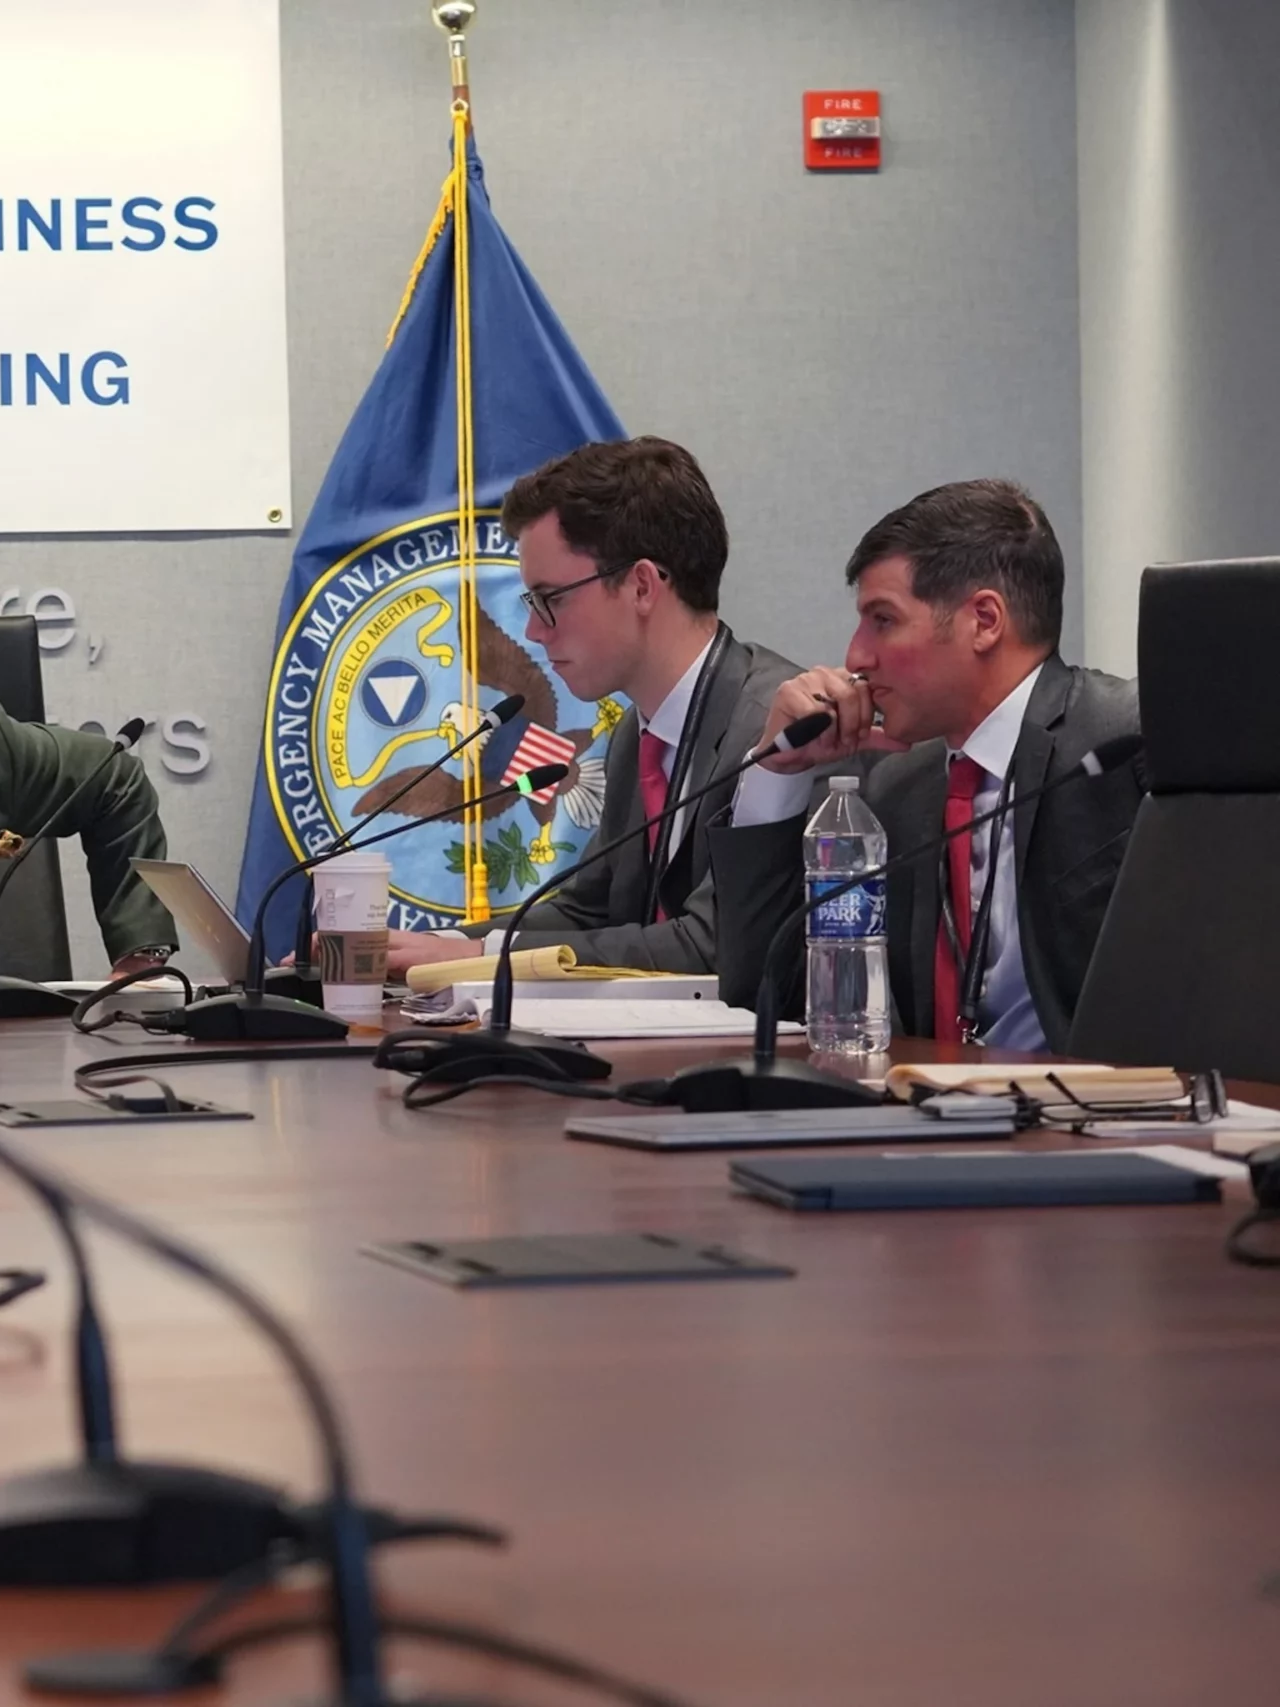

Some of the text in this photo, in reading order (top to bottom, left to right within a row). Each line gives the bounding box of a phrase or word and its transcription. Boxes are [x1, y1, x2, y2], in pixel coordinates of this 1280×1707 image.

[823, 98, 863, 111] FIRE
[278, 521, 520, 858] ERGENCY MANAGEME
[330, 592, 427, 778] PACE AC BELLO MERITA
[818, 906, 862, 922] PARK
